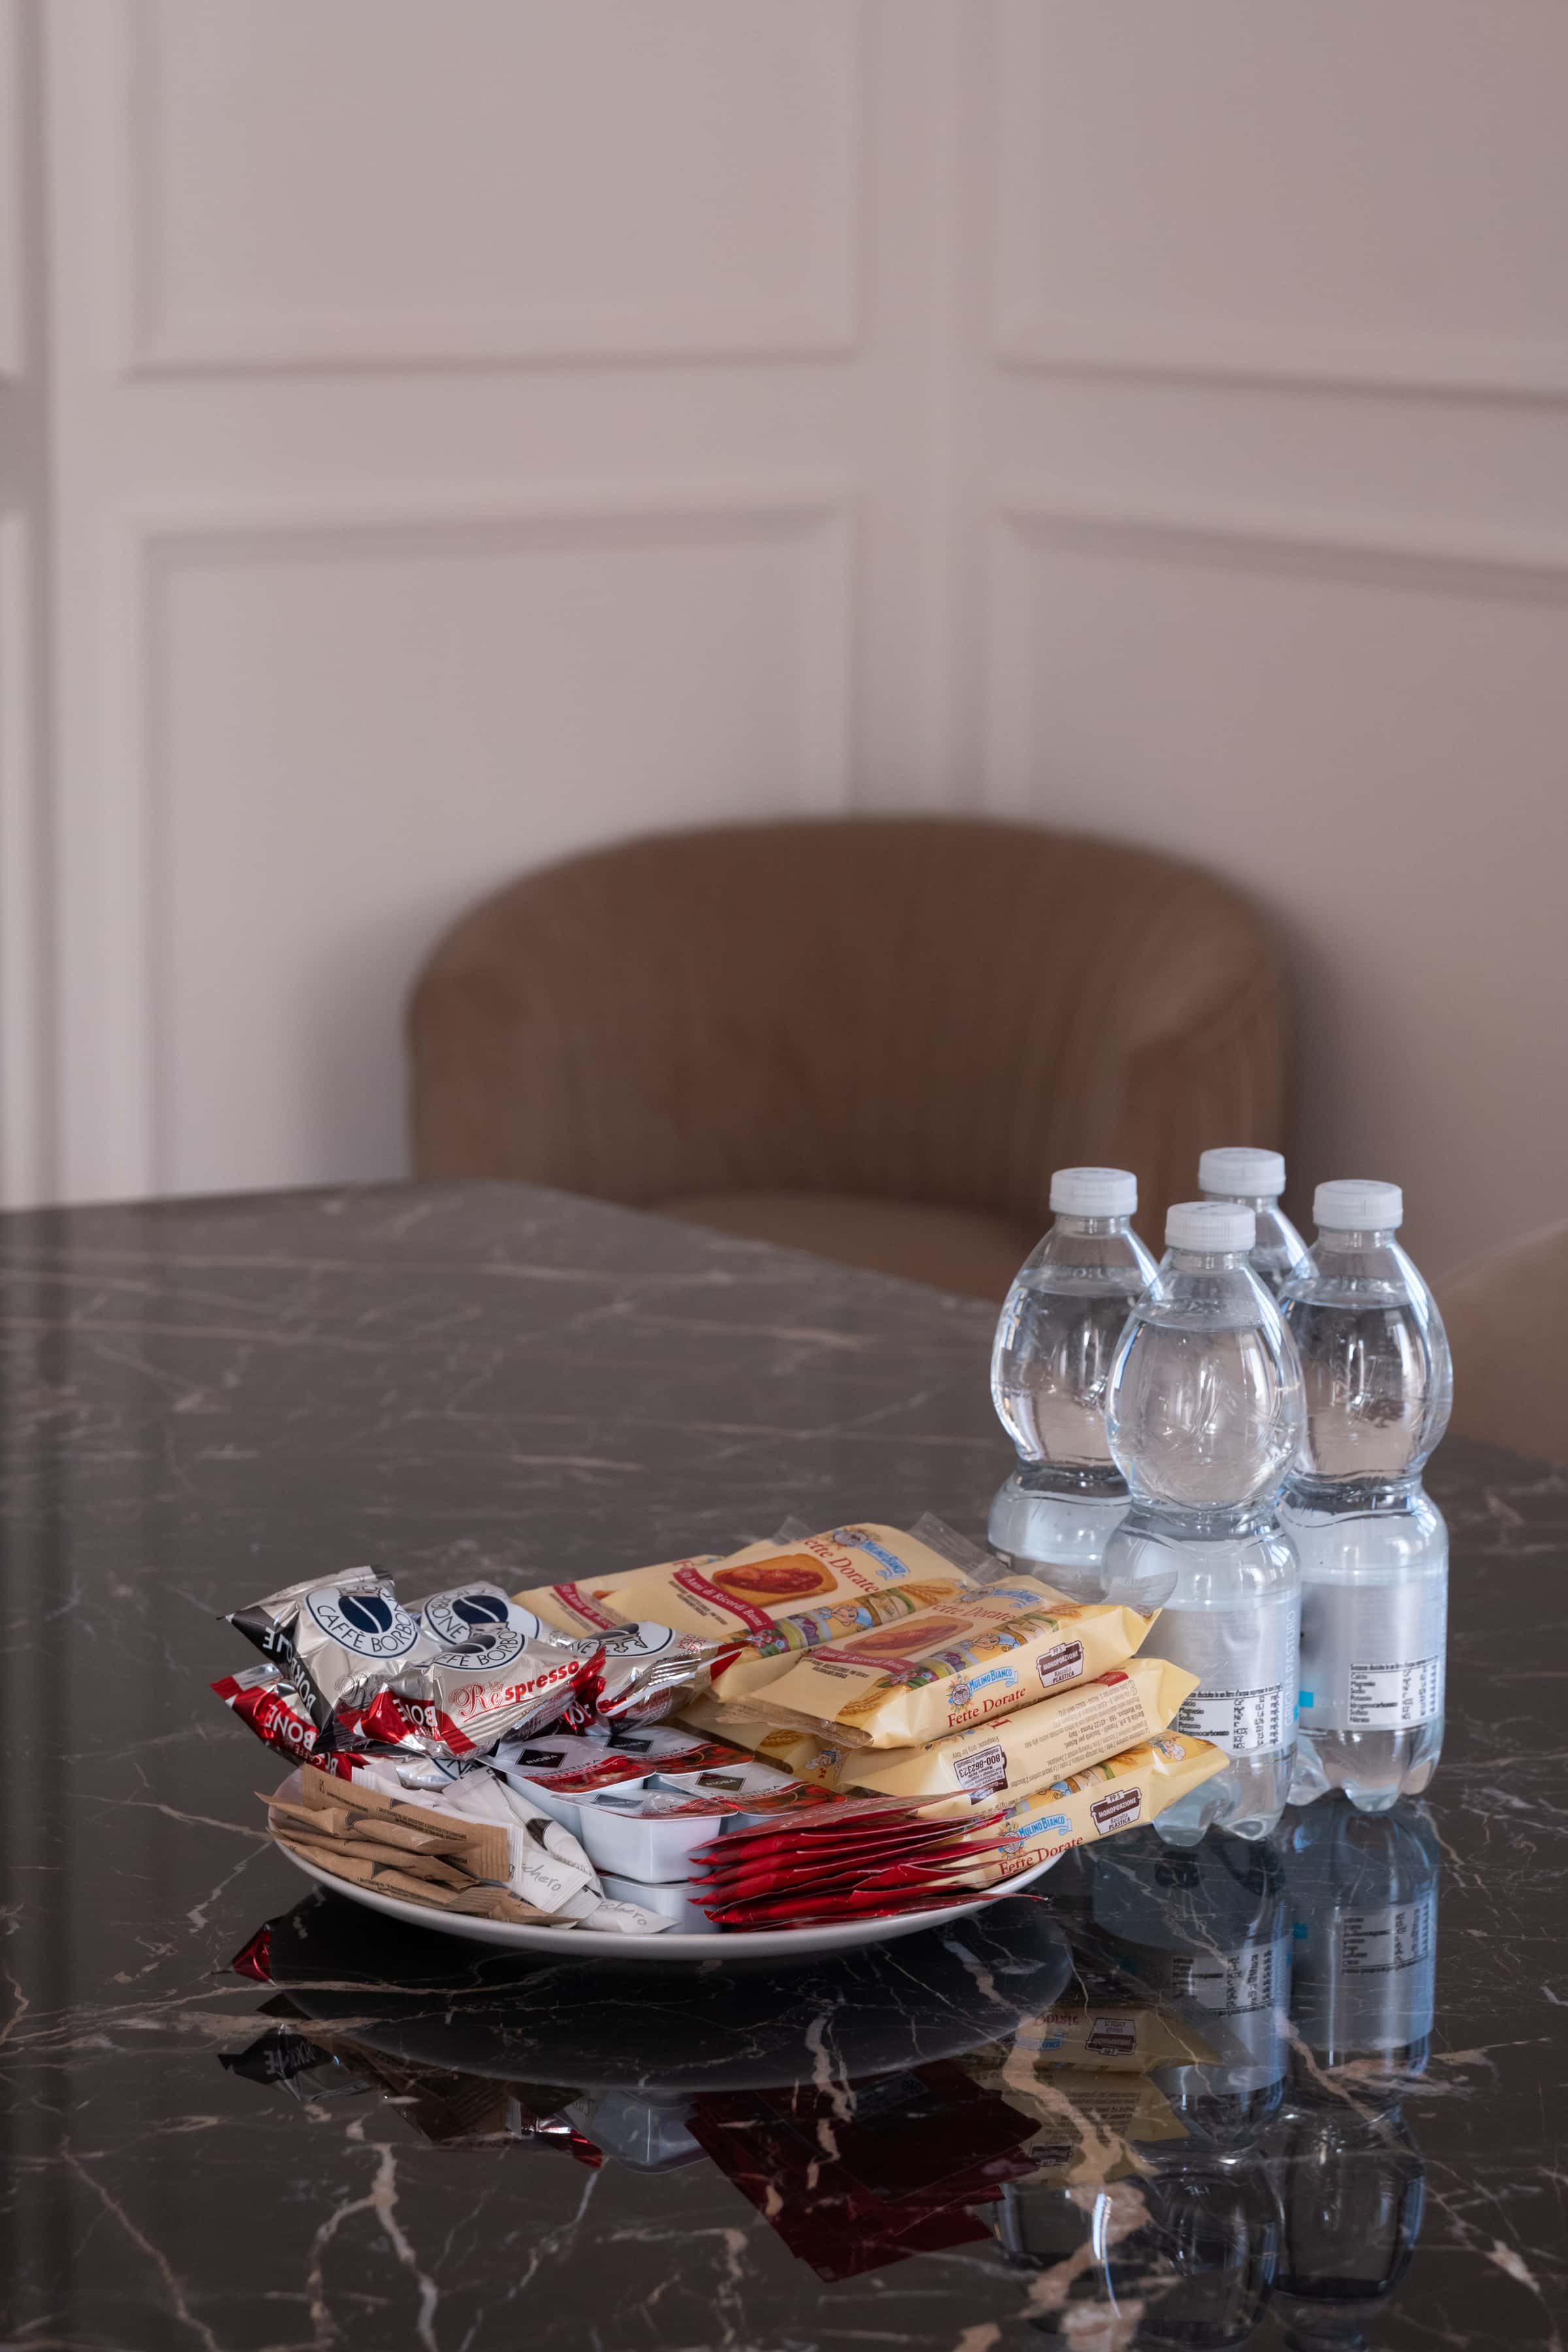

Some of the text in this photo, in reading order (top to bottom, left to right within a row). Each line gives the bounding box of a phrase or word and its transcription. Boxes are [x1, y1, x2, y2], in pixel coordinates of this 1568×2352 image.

[804, 1537, 879, 1593] ette Dorate
[317, 1605, 366, 1649] CAFFÈ
[477, 1631, 518, 1666] BORBO
[1285, 1610, 1296, 1673] PASTURO
[1043, 1650, 1079, 1671] MONOPORZIONE
[970, 1667, 1013, 1690] MULINO BIANCO
[1053, 1671, 1075, 1684] PLASTICA
[947, 1707, 979, 1728] Fette
[982, 1688, 1026, 1714] Dorate
[525, 1755, 558, 1765] RIOBA
[958, 1754, 1000, 1778] 800-862323
[1098, 1797, 1139, 1818] MONOPORZIONE
[1018, 1815, 1066, 1837] MULINO BIANCO
[1109, 1818, 1131, 1830] PLASTICA
[998, 1837, 1083, 1875] Fette Dorate
